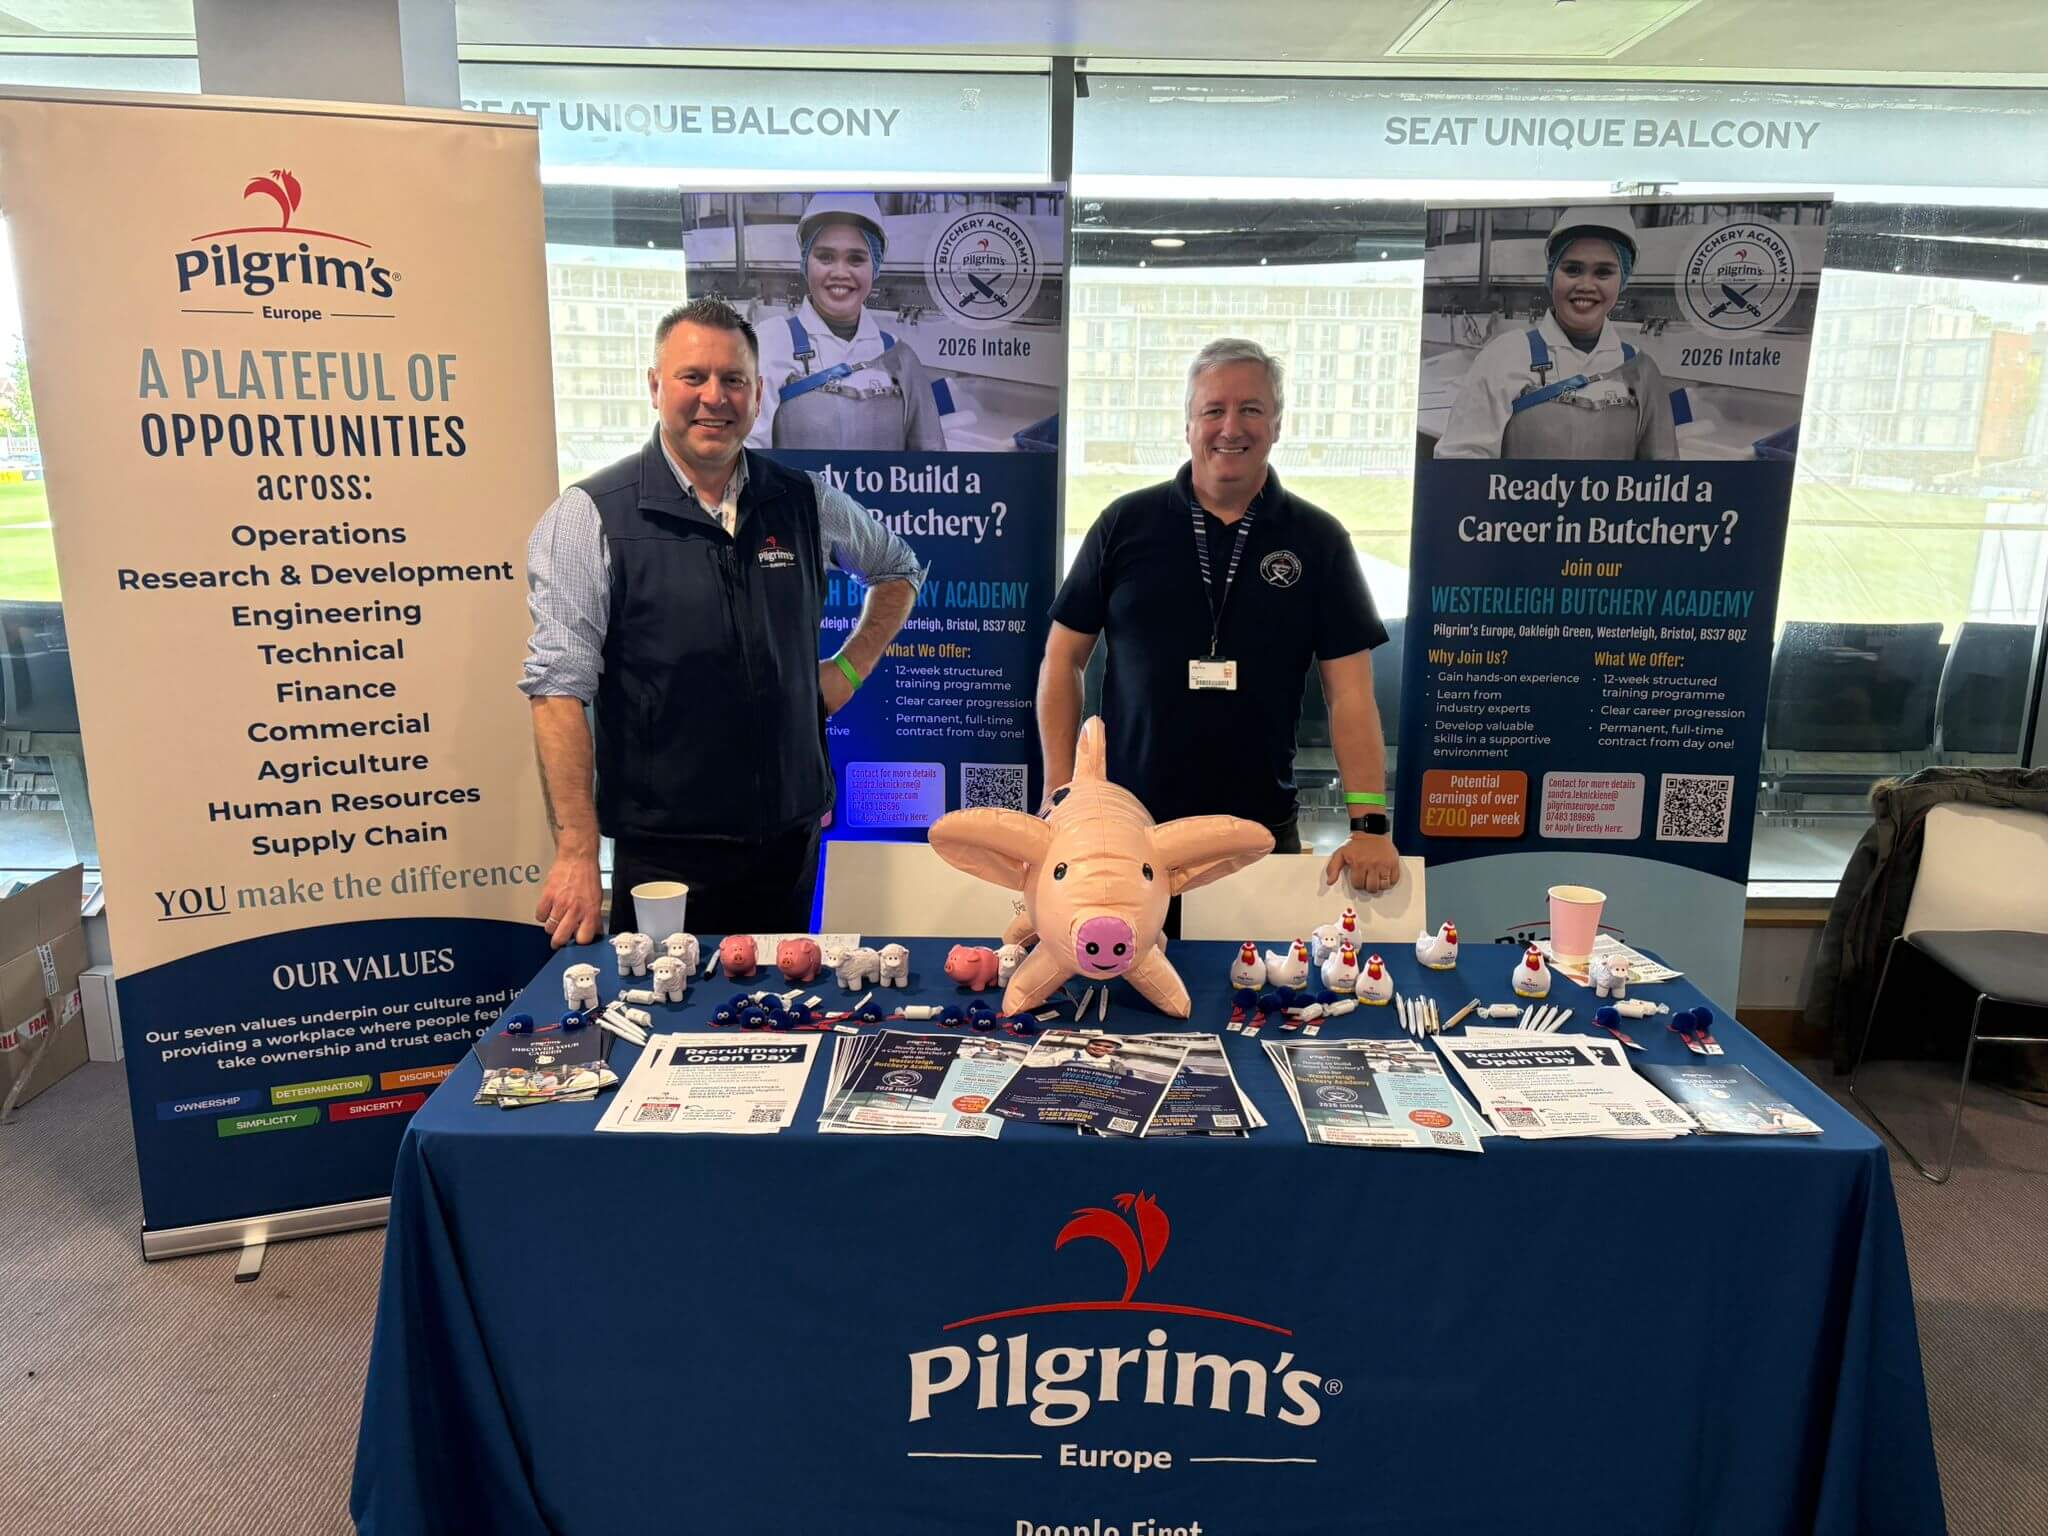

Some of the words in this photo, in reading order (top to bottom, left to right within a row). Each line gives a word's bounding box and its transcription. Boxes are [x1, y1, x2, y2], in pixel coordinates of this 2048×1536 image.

[558, 102, 702, 136] UNIQUE
[711, 106, 901, 138] BALCONY
[1383, 116, 1478, 146] SEAT
[1484, 117, 1625, 151] UNIQUE
[1632, 119, 1821, 150] BALCONY
[939, 219, 984, 264] BUTCHERY
[987, 219, 1029, 265] ACADEMY
[1692, 229, 1744, 275] BUTCHERY
[1747, 230, 1788, 275] ACADEMY
[262, 305, 323, 323] Europe
[939, 338, 976, 356] 2026
[982, 337, 1030, 356] Intake
[1681, 348, 1722, 366] 2026
[1729, 347, 1781, 366] Intake
[139, 348, 169, 400] A
[181, 349, 395, 402] PLATEFUL
[407, 354, 458, 402] OF
[141, 412, 467, 458] OPPORTUNITIES
[256, 471, 373, 501] across:
[855, 466, 883, 493] to
[889, 464, 958, 494] Build
[965, 472, 981, 494] a
[1488, 473, 1575, 508] Ready
[1581, 476, 1609, 502] to
[1615, 473, 1689, 503] Build
[1695, 481, 1713, 503] a
[230, 522, 407, 552] Operations
[1457, 515, 1551, 543] Career
[1555, 515, 1581, 544] in
[1587, 509, 1739, 552] Butchery?
[117, 564, 270, 591] Research
[280, 565, 301, 587] &
[310, 560, 515, 587] Development
[1561, 558, 1592, 577] Join
[1597, 562, 1623, 577] our
[945, 581, 1029, 609] ACADEMY
[1431, 586, 1555, 614] WESTERLEIGH
[1560, 587, 1658, 616] BUTCHERY
[1661, 589, 1754, 619] ACADEMY
[231, 600, 422, 631] Engineering
[946, 619, 981, 633] Bristol,
[983, 620, 1006, 632] BS37
[1008, 620, 1026, 634] 8QZ
[1433, 623, 1478, 638] Pilgrim's
[1481, 625, 1516, 639] Europe,
[1519, 625, 1559, 639] Oakleigh
[1562, 626, 1594, 640] Green,
[1597, 625, 1658, 641] Westerleigh,
[1660, 627, 1697, 642] Bristol,
[1700, 628, 1725, 640] BS37
[1727, 628, 1748, 643] 8QZ
[257, 638, 405, 665] Technical
[885, 643, 914, 657] What
[918, 644, 935, 657] We
[939, 643, 971, 658] Offer:
[1428, 649, 1454, 666] Why
[1457, 649, 1483, 664] Join
[1486, 650, 1508, 664] Us?
[1594, 651, 1625, 666] What
[1628, 652, 1646, 667] We
[1650, 652, 1684, 668] Offer:
[896, 666, 941, 675] 12-week
[943, 667, 1002, 677] structured
[1438, 671, 1463, 682] Gain
[1466, 672, 1517, 682] hands-on
[1519, 673, 1580, 684] experience
[1604, 674, 1649, 684] 12-week
[1652, 677, 1717, 686] structured
[276, 680, 397, 703] Finance
[895, 679, 940, 690] training
[943, 680, 1011, 691] programme
[1602, 688, 1648, 699] training
[1651, 690, 1725, 700] programme
[896, 696, 924, 705] Clear
[928, 698, 963, 706] career
[966, 699, 1032, 709] progression
[1437, 690, 1470, 699] Learn
[1474, 690, 1502, 700] from
[1436, 703, 1485, 715] industry
[1488, 704, 1531, 714] experts
[1600, 706, 1631, 715] Clear
[1633, 707, 1670, 716] career
[1673, 708, 1745, 719] progression
[247, 712, 431, 743] Commercial
[896, 713, 963, 724] Permanent,
[965, 714, 1013, 725] full-time
[1435, 720, 1483, 732] Develop
[1486, 721, 1534, 731] valuable
[896, 727, 943, 736] contract
[946, 727, 974, 736] from
[977, 728, 998, 739] day
[1000, 729, 1025, 739] one!
[1599, 723, 1668, 735] Permanent,
[1671, 724, 1724, 735] full-time
[1433, 734, 1463, 744] skills
[1466, 734, 1476, 744] in
[1479, 736, 1486, 744] a
[1489, 734, 1551, 745] supportive
[1598, 737, 1647, 746] contract
[1650, 737, 1680, 747] from
[1683, 738, 1705, 750] day
[1708, 739, 1735, 749] one!
[1433, 747, 1508, 757] environment
[257, 751, 429, 784] Agriculture
[1450, 774, 1500, 788] Potential
[208, 797, 322, 822] Human
[331, 785, 482, 814] Resources
[1429, 791, 1478, 807] earnings
[1481, 791, 1492, 804] of
[1494, 794, 1519, 804] over
[1426, 807, 1467, 826] £700
[1470, 814, 1489, 827] per
[1492, 812, 1520, 825] week
[251, 829, 356, 857] Supply
[364, 821, 448, 847] Chain
[155, 884, 229, 918] YOU
[236, 877, 324, 910] make
[332, 871, 382, 900] the
[390, 861, 541, 896] difference
[272, 960, 339, 990] OUR
[342, 947, 455, 982] VALUES
[145, 1030, 180, 1044] Our
[184, 1023, 236, 1039] seven
[241, 1016, 297, 1032] values
[301, 1005, 378, 1025] underpin
[382, 1004, 410, 1015] our
[414, 996, 471, 1011] culture
[475, 989, 505, 1004] and
[161, 1038, 247, 1062] providing
[252, 1038, 262, 1048] a
[266, 1025, 355, 1046] workplace
[359, 1019, 412, 1035] where
[416, 1012, 470, 1030] people
[474, 1007, 503, 1021] feel
[217, 1055, 256, 1070] take
[260, 1042, 351, 1064] ownership
[355, 1038, 386, 1052] and
[390, 1034, 430, 1048] trust
[434, 1028, 471, 1042] each
[685, 1047, 798, 1055] Recruitment
[688, 1054, 744, 1063] Open
[752, 1054, 792, 1062] Day
[1464, 1049, 1575, 1059] Recruitment
[1476, 1056, 1533, 1067] Open
[1537, 1056, 1576, 1065] Day
[276, 1080, 363, 1099] DETERMINATION
[174, 1096, 241, 1113] OWNERSHIP
[349, 1100, 403, 1114] SINCERITY
[236, 1114, 298, 1130] SIMPLICITY
[1059, 1443, 1173, 1474] Europe
